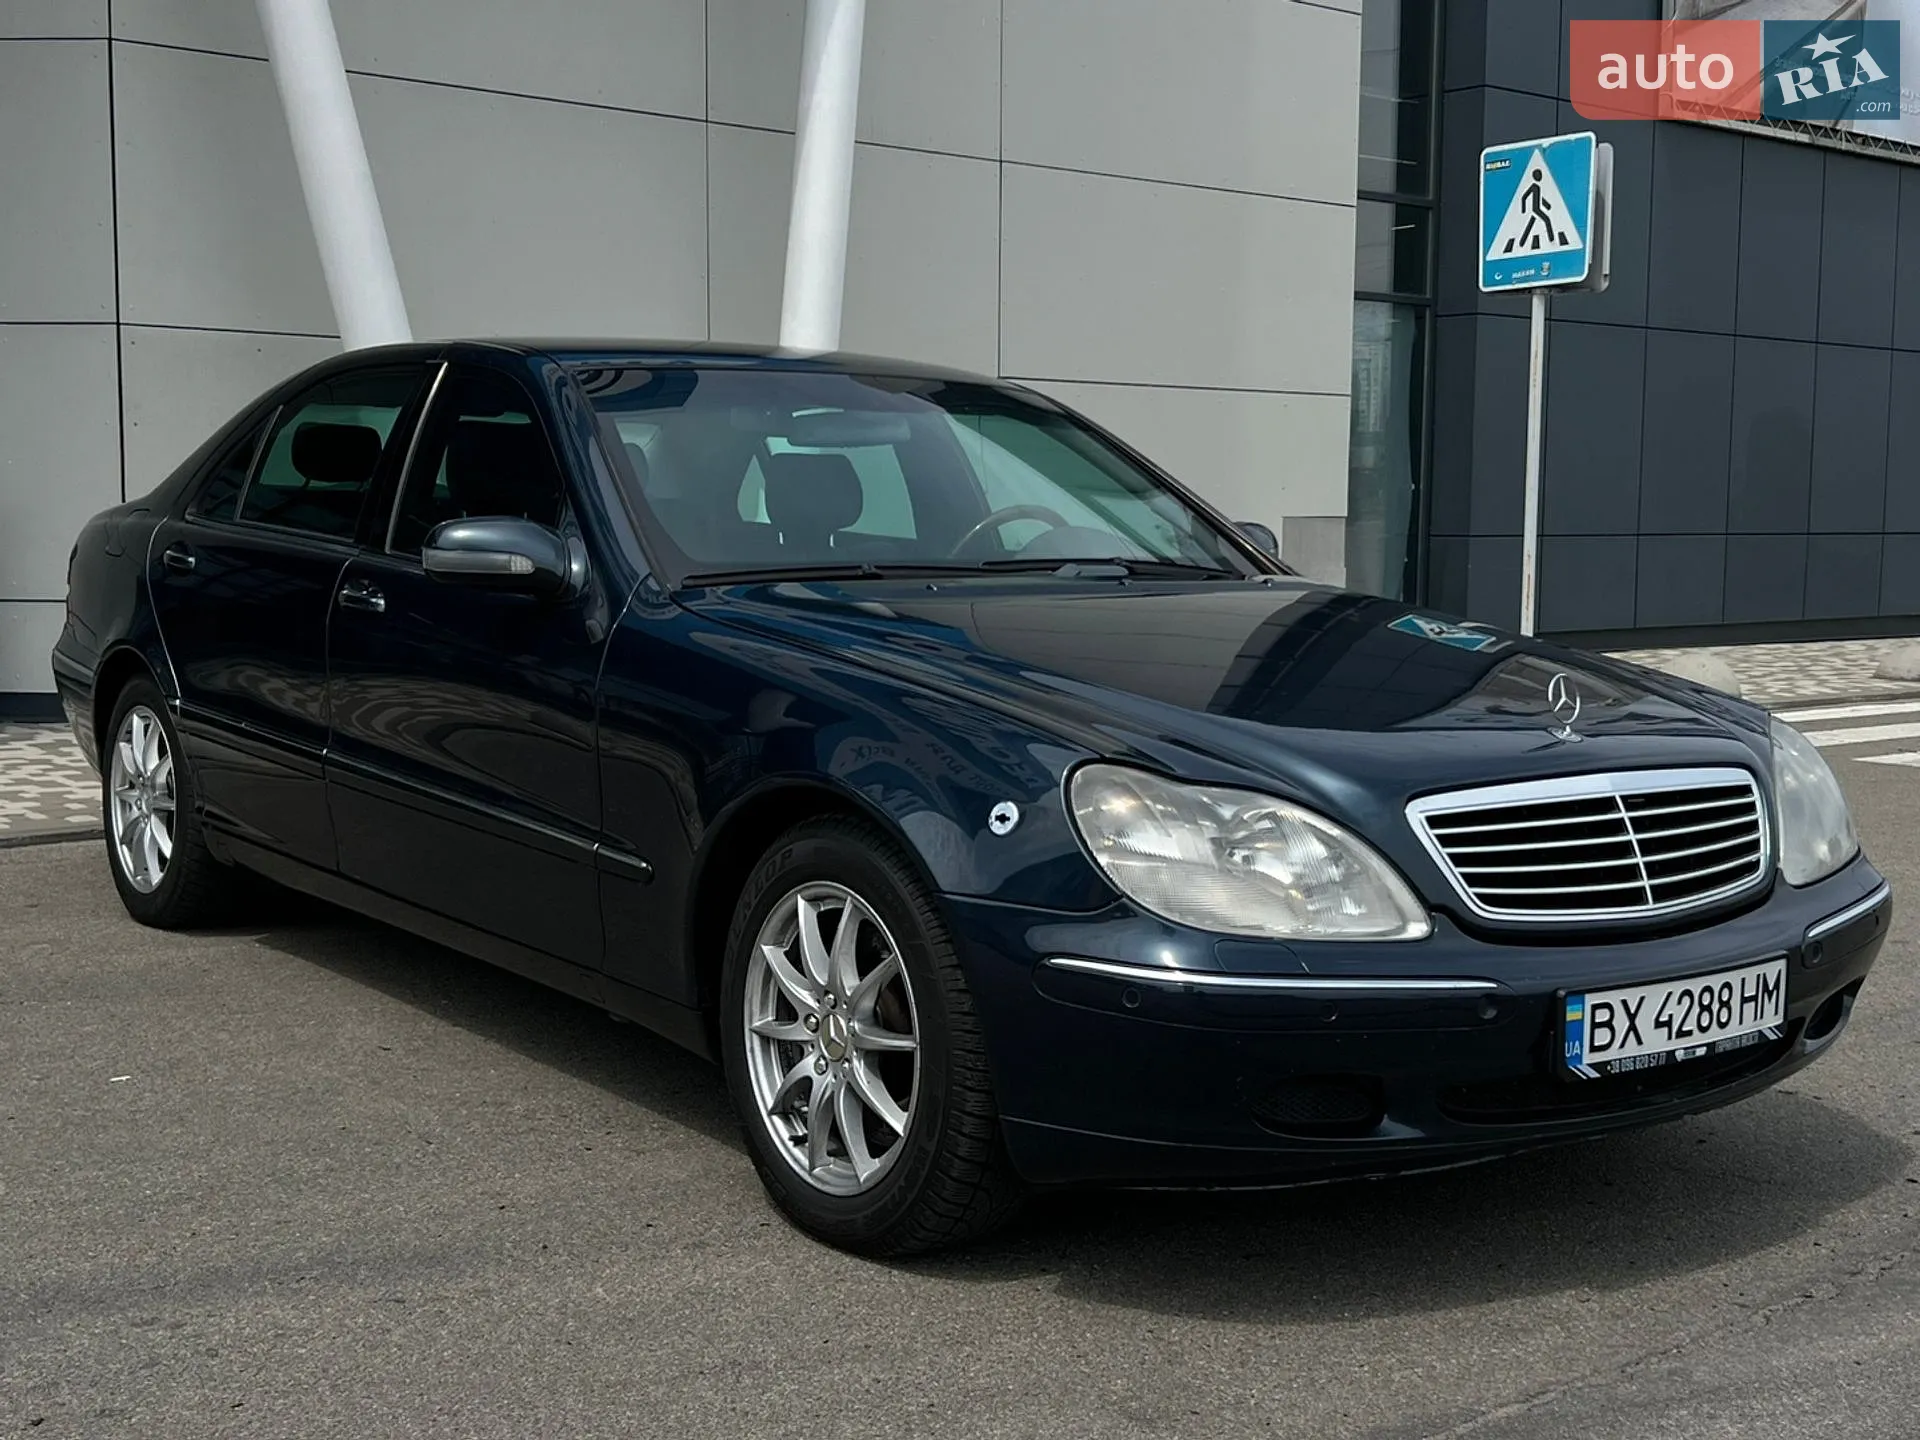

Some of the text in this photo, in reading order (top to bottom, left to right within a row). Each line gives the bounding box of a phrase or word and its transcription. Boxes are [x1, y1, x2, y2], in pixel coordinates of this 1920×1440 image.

[1589, 968, 1782, 1053] BX 4288 HM
[1565, 1040, 1581, 1058] UA
